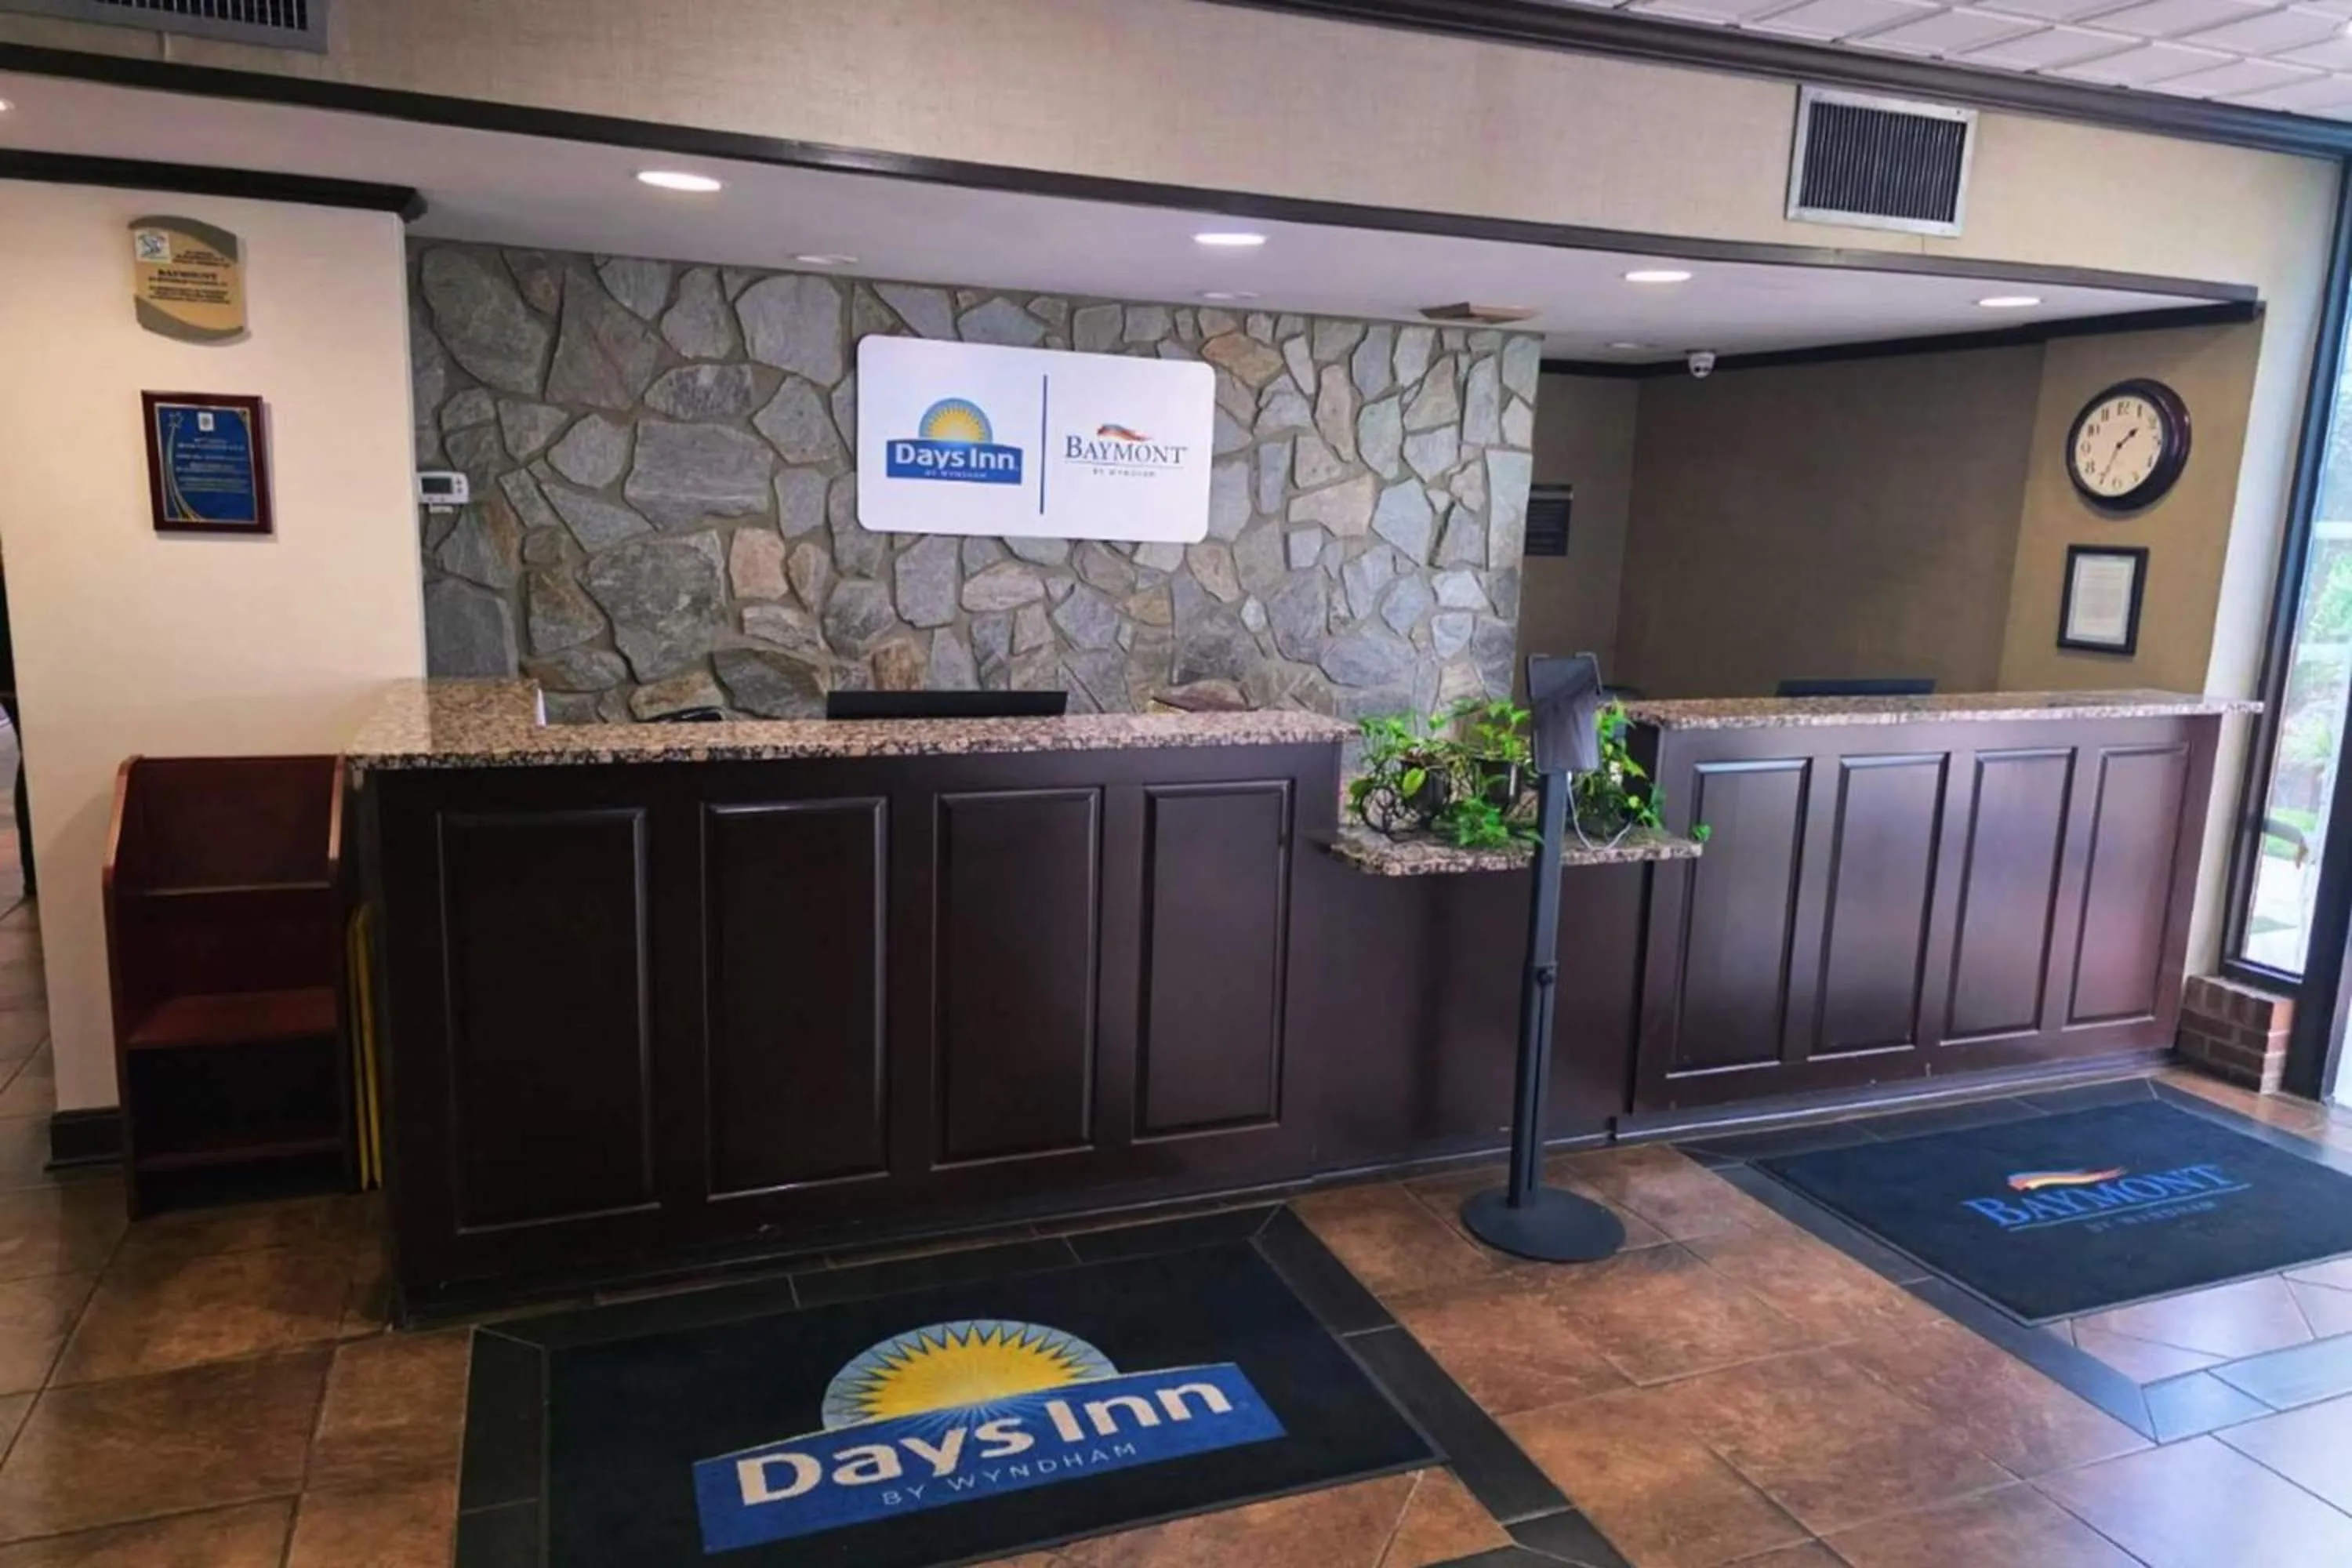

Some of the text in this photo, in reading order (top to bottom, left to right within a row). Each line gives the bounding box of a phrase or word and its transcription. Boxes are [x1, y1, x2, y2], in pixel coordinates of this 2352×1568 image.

[895, 442, 1015, 470] Days Inn
[1065, 434, 1189, 464] BAYMONT
[1962, 1164, 2234, 1228] BAYMONT
[737, 1382, 1233, 1506] Days Inn
[880, 1442, 1137, 1506] BY WYNDHAM
